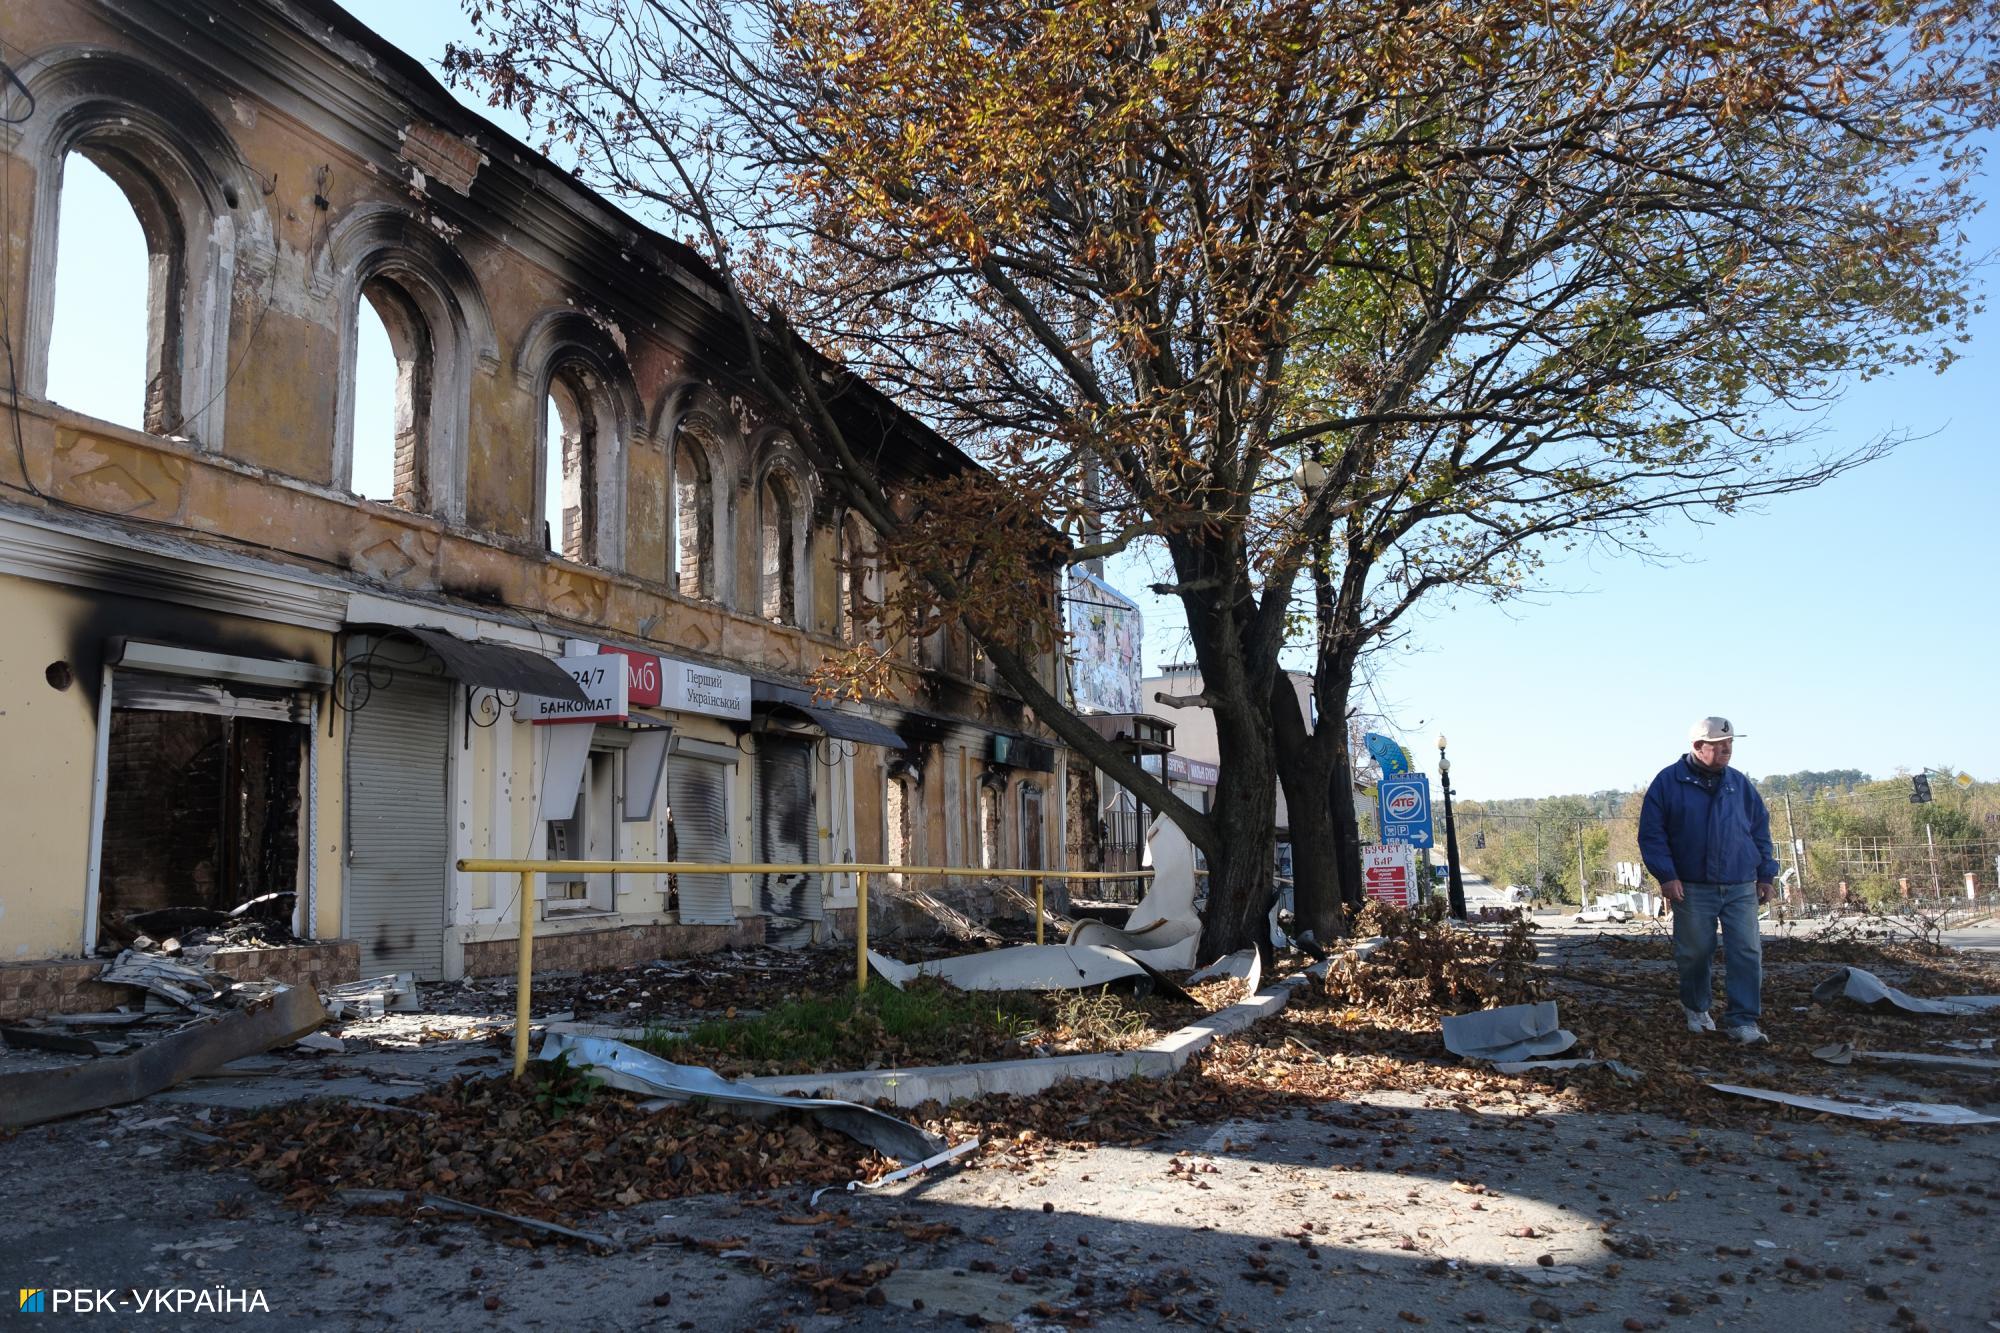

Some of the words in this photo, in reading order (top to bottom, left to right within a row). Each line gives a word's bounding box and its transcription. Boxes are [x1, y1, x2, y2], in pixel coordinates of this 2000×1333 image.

[572, 667, 605, 689] 24/7
[686, 669, 722, 689] Перший
[540, 699, 612, 714] БАНКОМАТ
[687, 690, 740, 711] Український
[1390, 797, 1415, 808] АТБ
[1364, 844, 1400, 854] БУФЕТ
[1373, 857, 1393, 866] БАР
